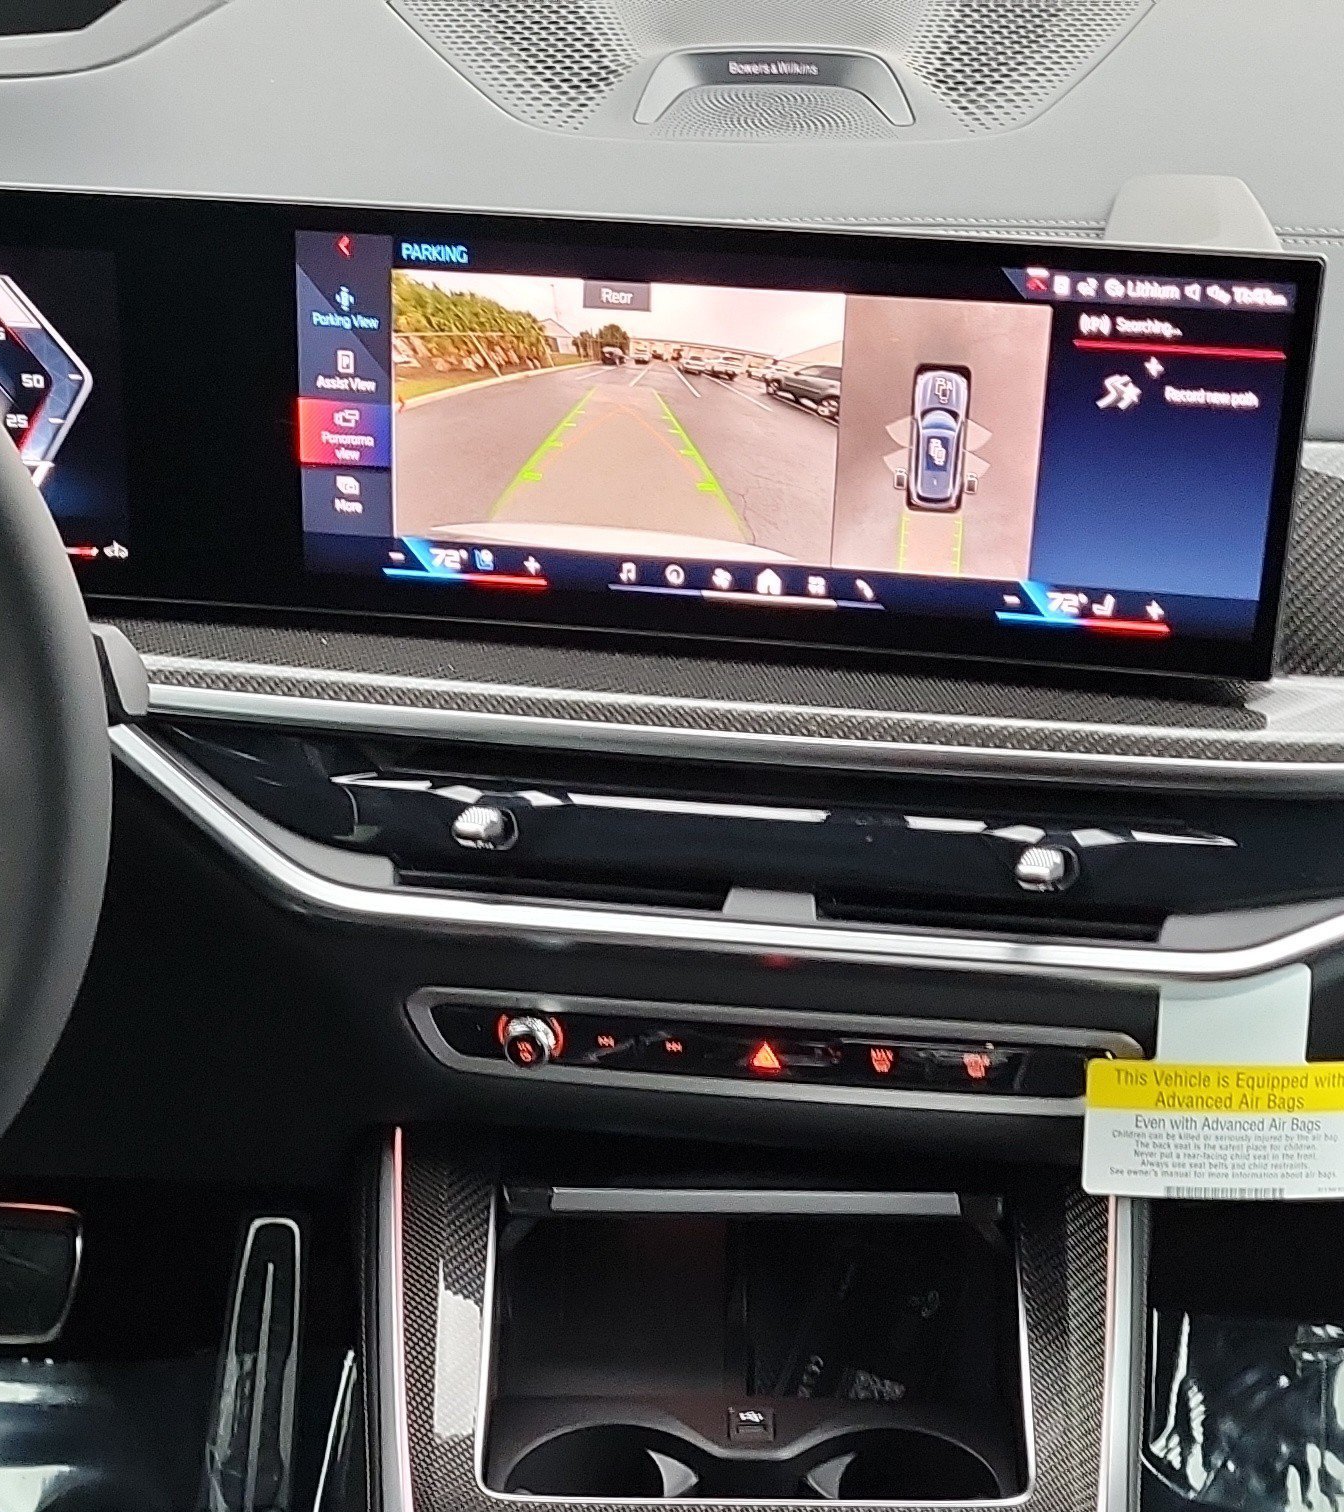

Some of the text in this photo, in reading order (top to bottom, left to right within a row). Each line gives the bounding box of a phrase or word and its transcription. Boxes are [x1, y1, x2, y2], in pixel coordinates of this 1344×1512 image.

[401, 242, 468, 263] PARKING
[600, 286, 634, 305] Rear
[1126, 279, 1181, 301] Lithium
[312, 311, 379, 330] Parking View
[20, 373, 45, 388] 50
[316, 374, 376, 393] Assist View
[6, 414, 29, 429] 25
[320, 430, 374, 447] Panorama
[335, 447, 360, 461] view
[334, 497, 363, 514] More
[1115, 1068, 1344, 1091] This Vehicle is Equipped with
[1156, 1091, 1305, 1112] Advanced Air Bags
[1135, 1114, 1321, 1134] Even with Advanced Air Bags
[1112, 1129, 1146, 1139] Children
[1149, 1132, 1163, 1140] can
[1166, 1132, 1176, 1140] be
[1179, 1132, 1200, 1141] killed
[1216, 1133, 1251, 1143] seriously
[1135, 1140, 1150, 1149] The
[1152, 1140, 1171, 1150] back
[1174, 1142, 1191, 1150] seat
[1204, 1142, 1216, 1151] the
[1134, 1149, 1157, 1158] Never
[1160, 1151, 1173, 1159] put
[1230, 1152, 1250, 1161] child
[1109, 1166, 1124, 1176] See
[1127, 1168, 1158, 1178] owner's
[1161, 1169, 1191, 1178] manual
[1231, 1170, 1278, 1180] information
[1281, 1170, 1303, 1180] about
[1141, 1159, 1169, 1169] Always
[1189, 1161, 1205, 1169] seat
[1208, 1161, 1228, 1170] belts
